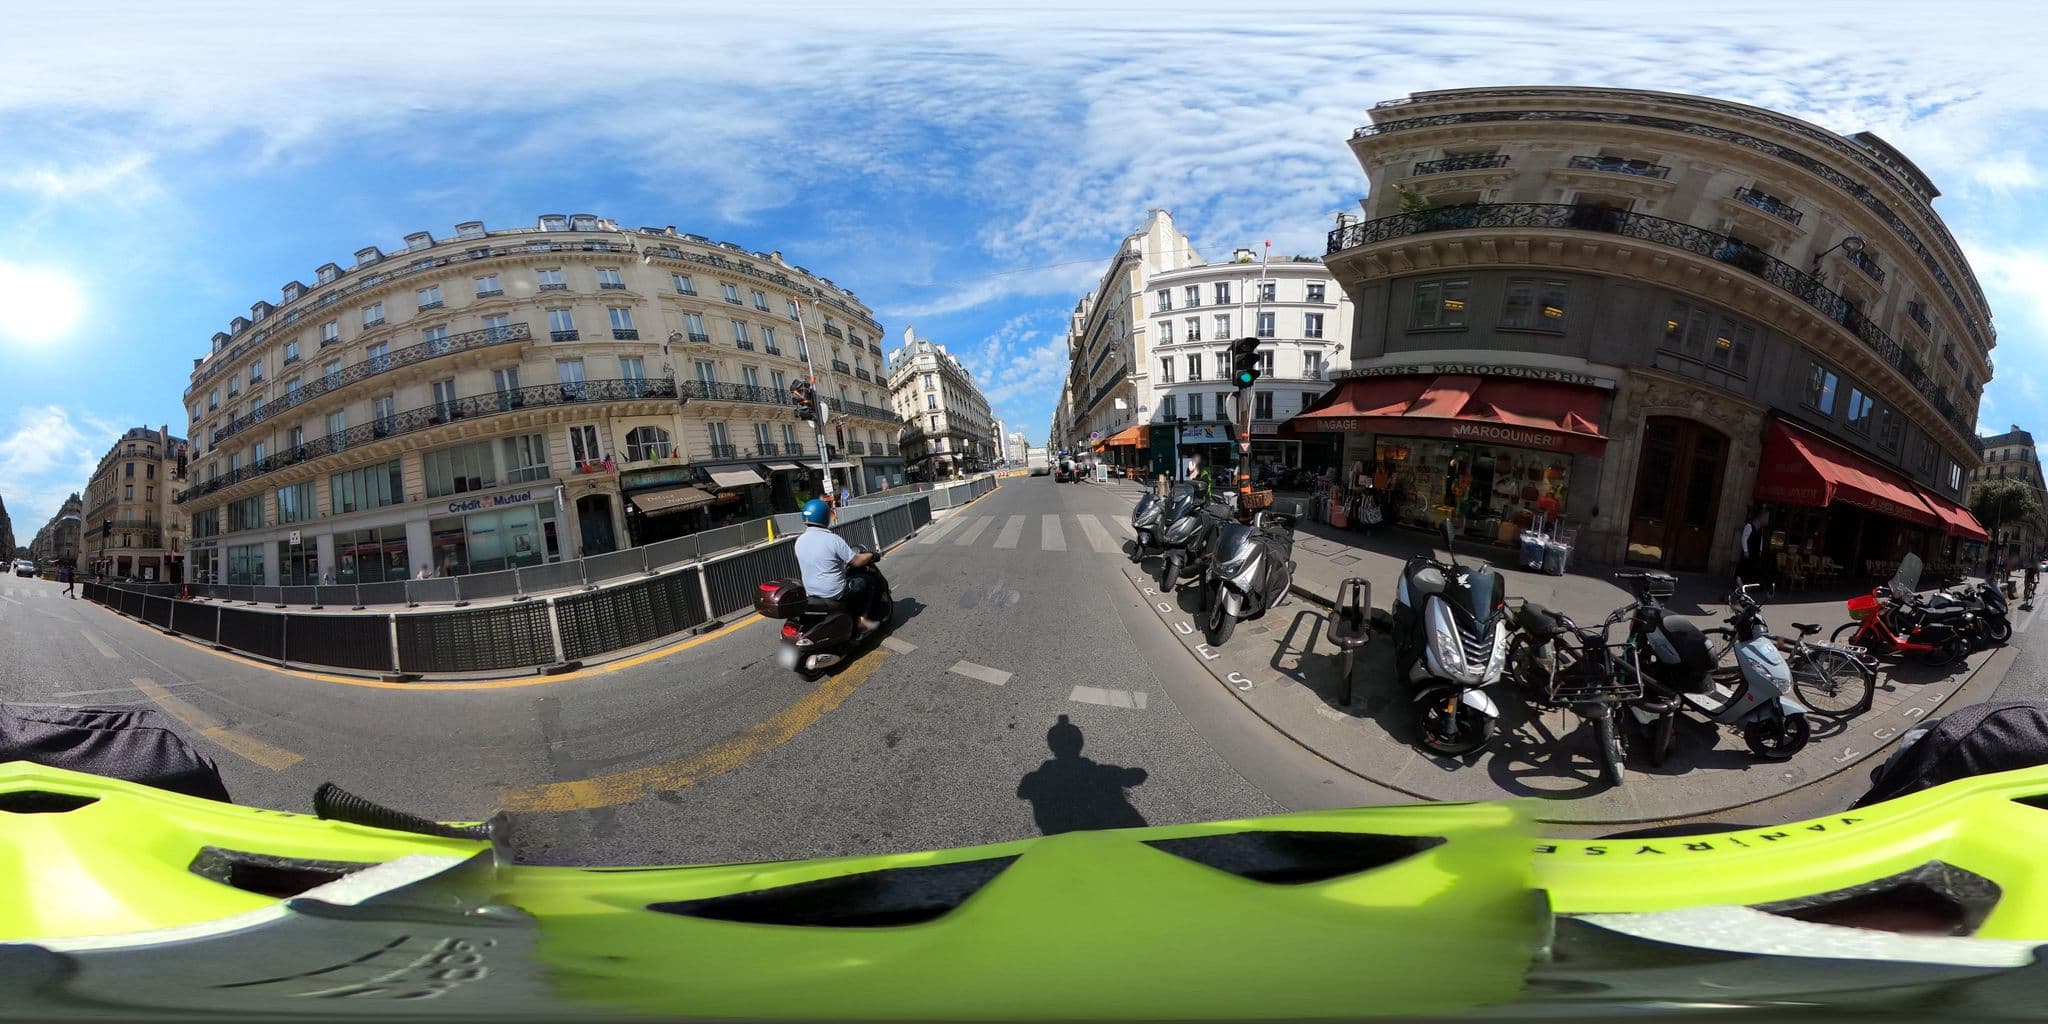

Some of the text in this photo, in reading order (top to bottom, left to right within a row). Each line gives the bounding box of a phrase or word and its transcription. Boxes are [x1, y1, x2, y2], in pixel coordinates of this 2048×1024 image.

[1341, 364, 1596, 386] BAGAGES MAROQUINERIE
[448, 491, 531, 513] Crédit Mutuel
